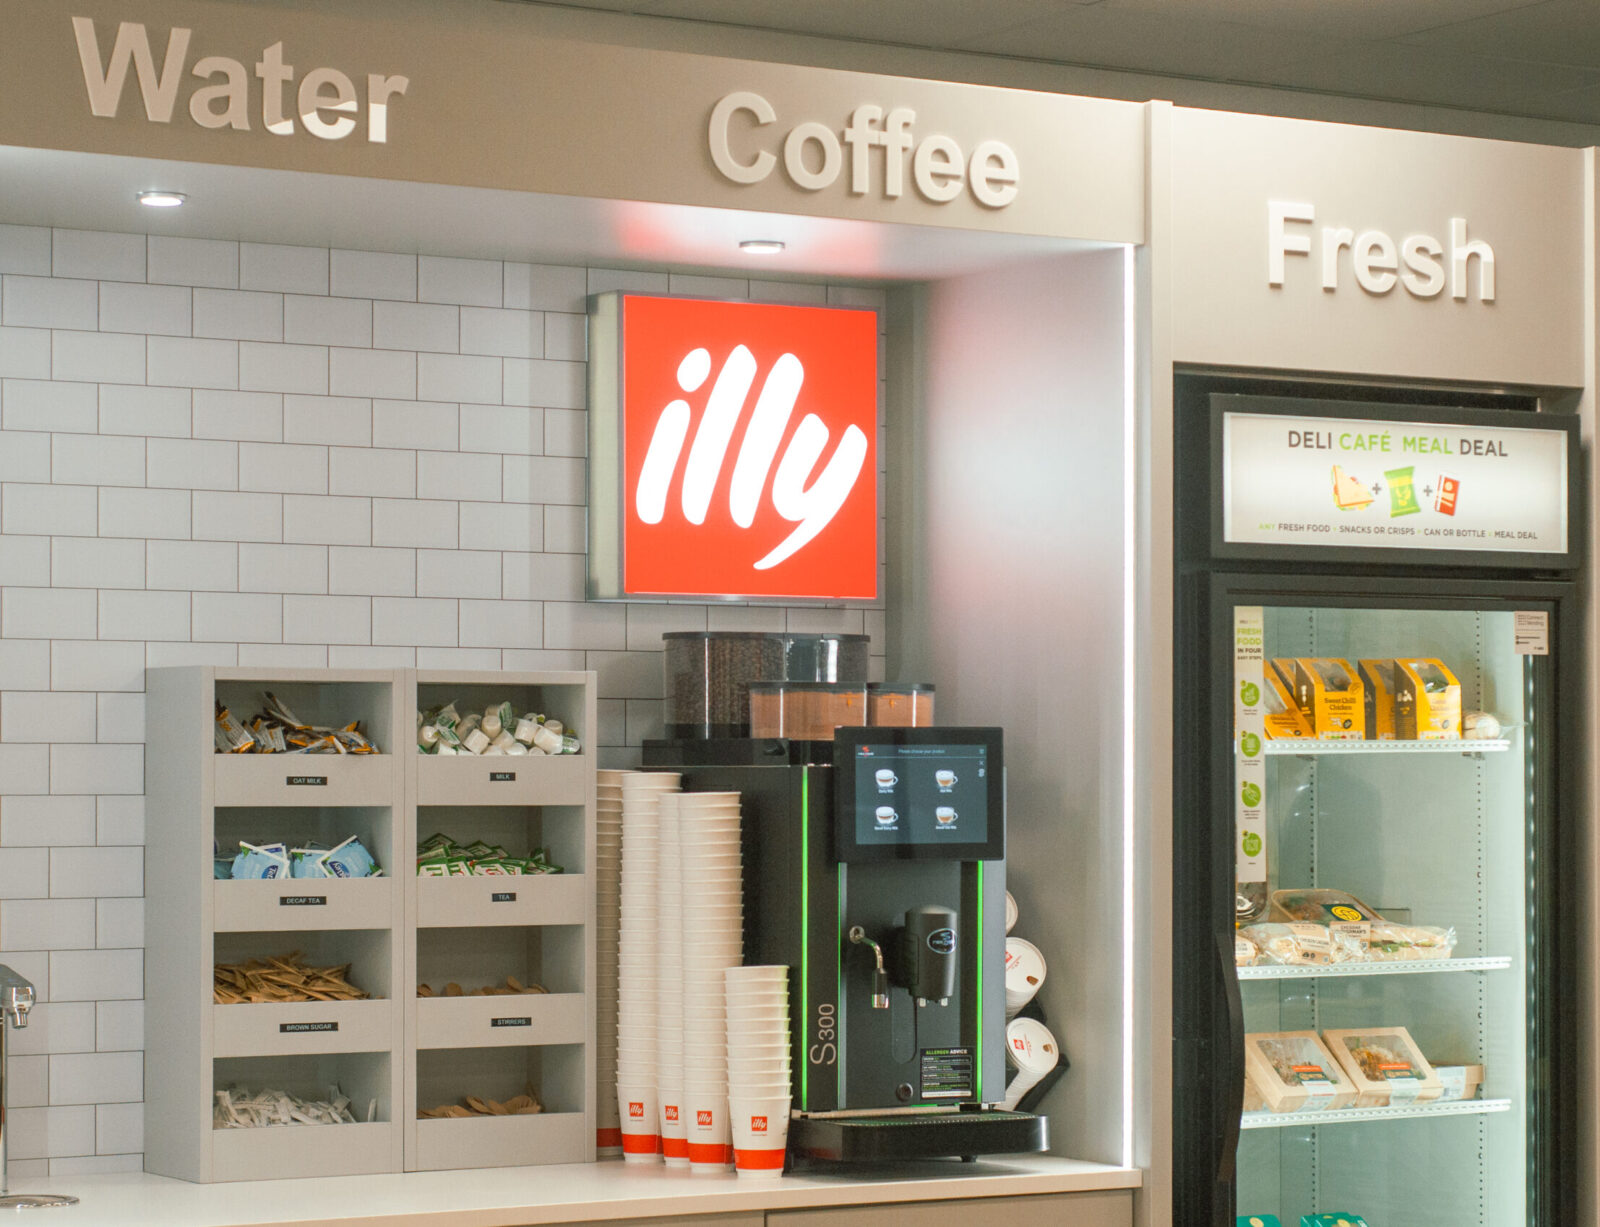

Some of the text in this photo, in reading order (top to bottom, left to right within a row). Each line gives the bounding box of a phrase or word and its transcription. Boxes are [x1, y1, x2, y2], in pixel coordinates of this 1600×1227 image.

[72, 16, 409, 144] Water
[707, 91, 1020, 207] Coffee
[1266, 199, 1496, 301] Fresh
[636, 344, 867, 570] illy
[1288, 430, 1508, 457] DELI CAFÉ MEAL DEAL
[1278, 523, 1304, 532] FRESH
[1307, 524, 1330, 532] FOOD
[1339, 525, 1372, 534] SNACKS
[1387, 527, 1415, 535] CRISPS
[1424, 528, 1440, 536] CAN
[1443, 528, 1454, 536] OR
[1456, 529, 1486, 538] BOTTLE
[1494, 530, 1515, 539] MEAL
[1517, 531, 1538, 540] DEAL
[810, 1003, 837, 1065] S300
